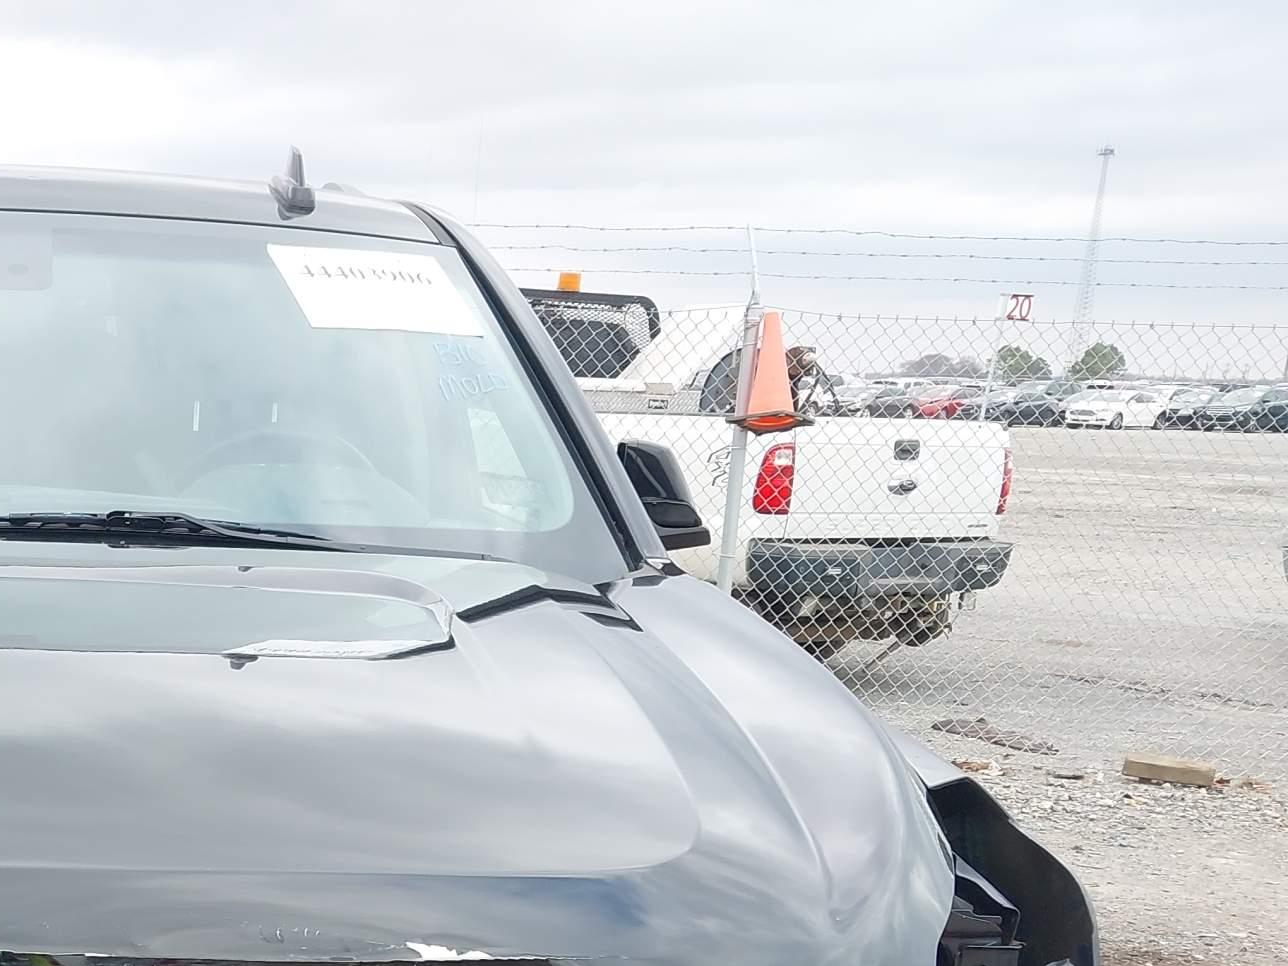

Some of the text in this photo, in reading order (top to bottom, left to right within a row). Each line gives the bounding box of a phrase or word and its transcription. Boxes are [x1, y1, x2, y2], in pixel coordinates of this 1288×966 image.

[300, 264, 433, 286] 44403906
[1006, 294, 1035, 322] 20
[439, 371, 513, 401] MOLD
